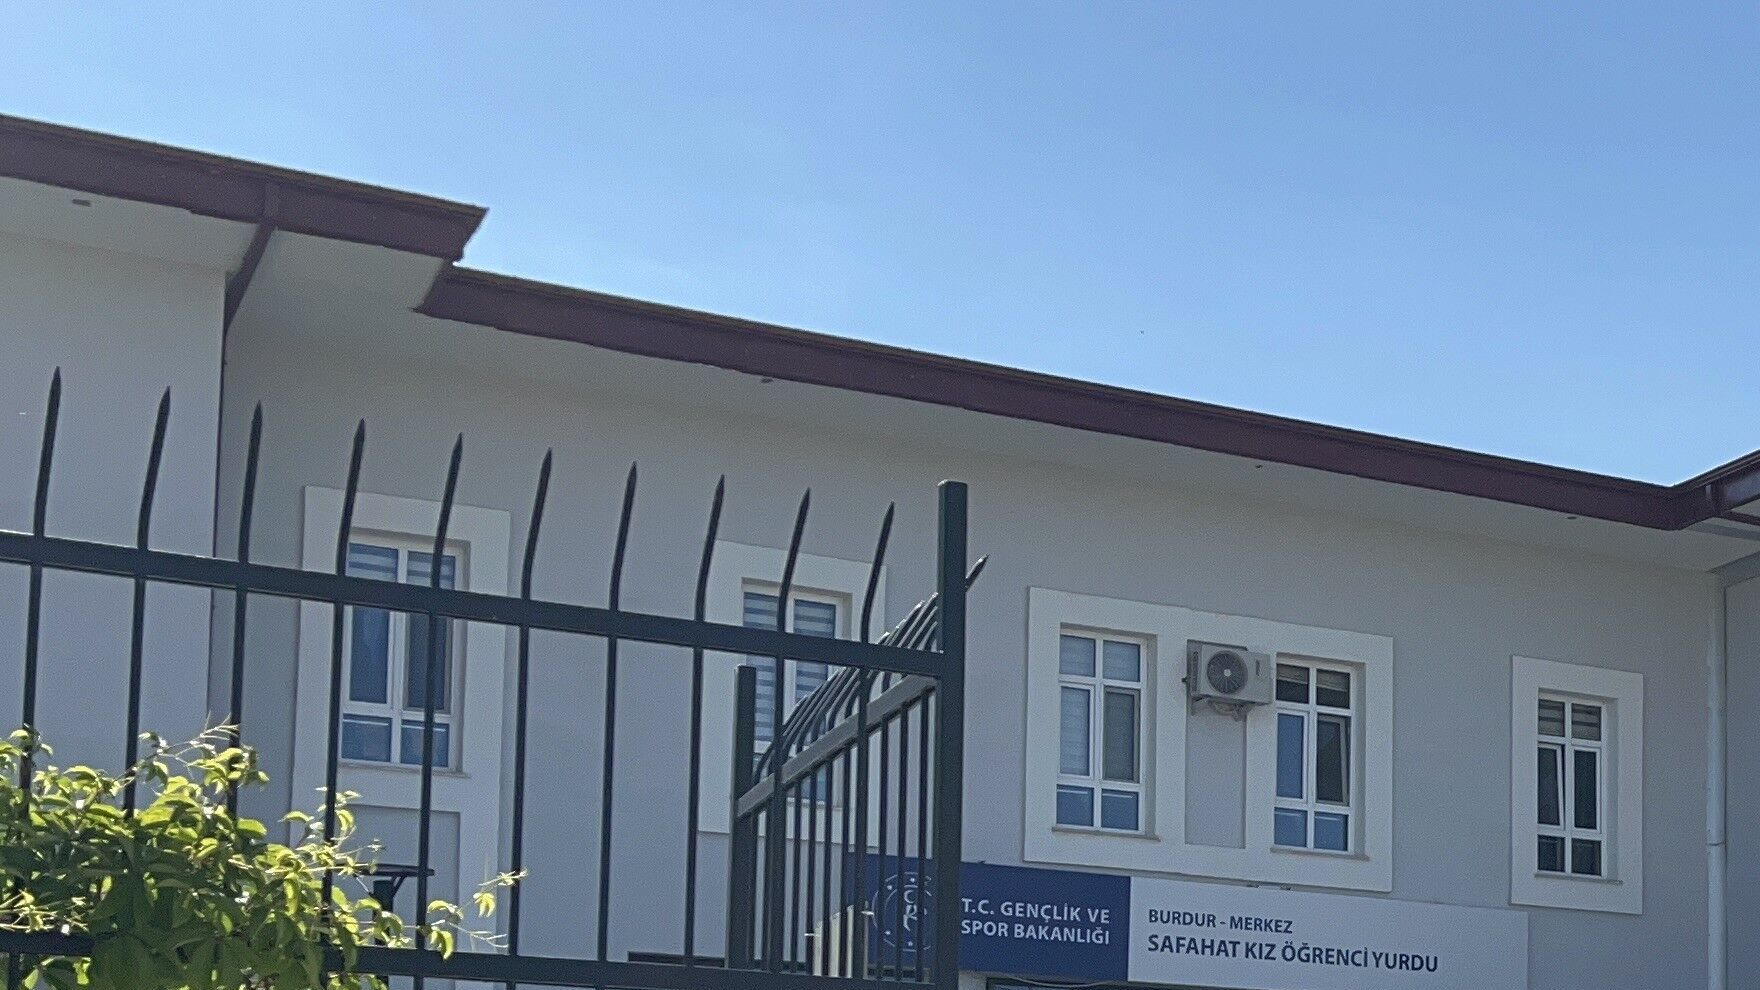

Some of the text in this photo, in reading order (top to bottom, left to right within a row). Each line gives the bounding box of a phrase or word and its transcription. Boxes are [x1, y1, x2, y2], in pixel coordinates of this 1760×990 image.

[961, 897, 1110, 924] T.C. GENÇLİK VE
[1148, 908, 1217, 928] BURDUR
[1229, 915, 1293, 934] MERKEZ
[961, 919, 1110, 945] SPOR BAKANLIĞI
[1147, 934, 1439, 973] SAFAHAT KIZ ÖĞRENCİ YURDU
